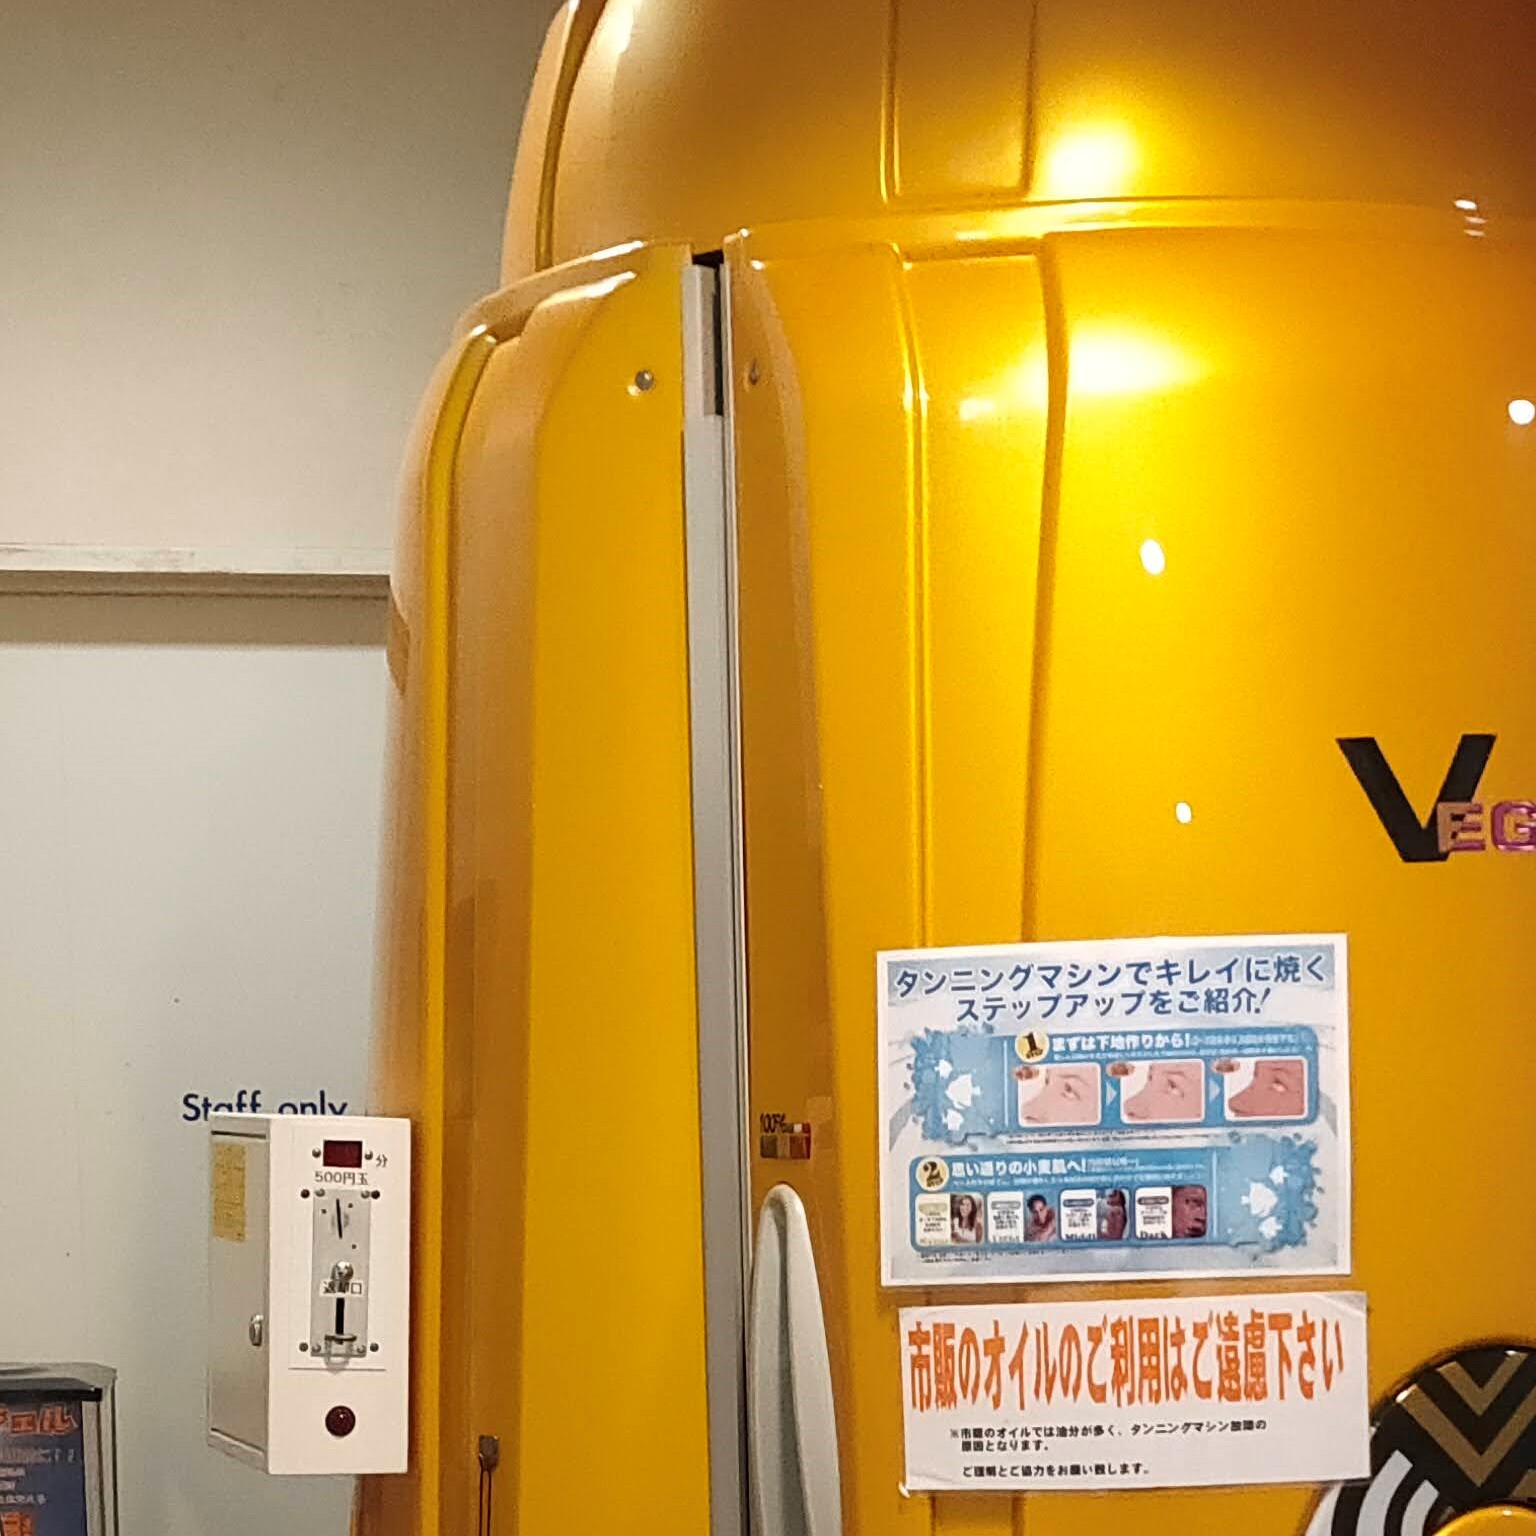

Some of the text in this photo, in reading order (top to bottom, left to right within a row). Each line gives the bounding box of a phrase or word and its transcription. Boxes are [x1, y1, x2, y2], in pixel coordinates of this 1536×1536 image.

[896, 954, 1325, 998] タンニングマシンでキレイに焼く
[376, 1154, 388, 1168] 分
[907, 1308, 1344, 1412] 市販のオイルのご利用はご遠慮下さい
